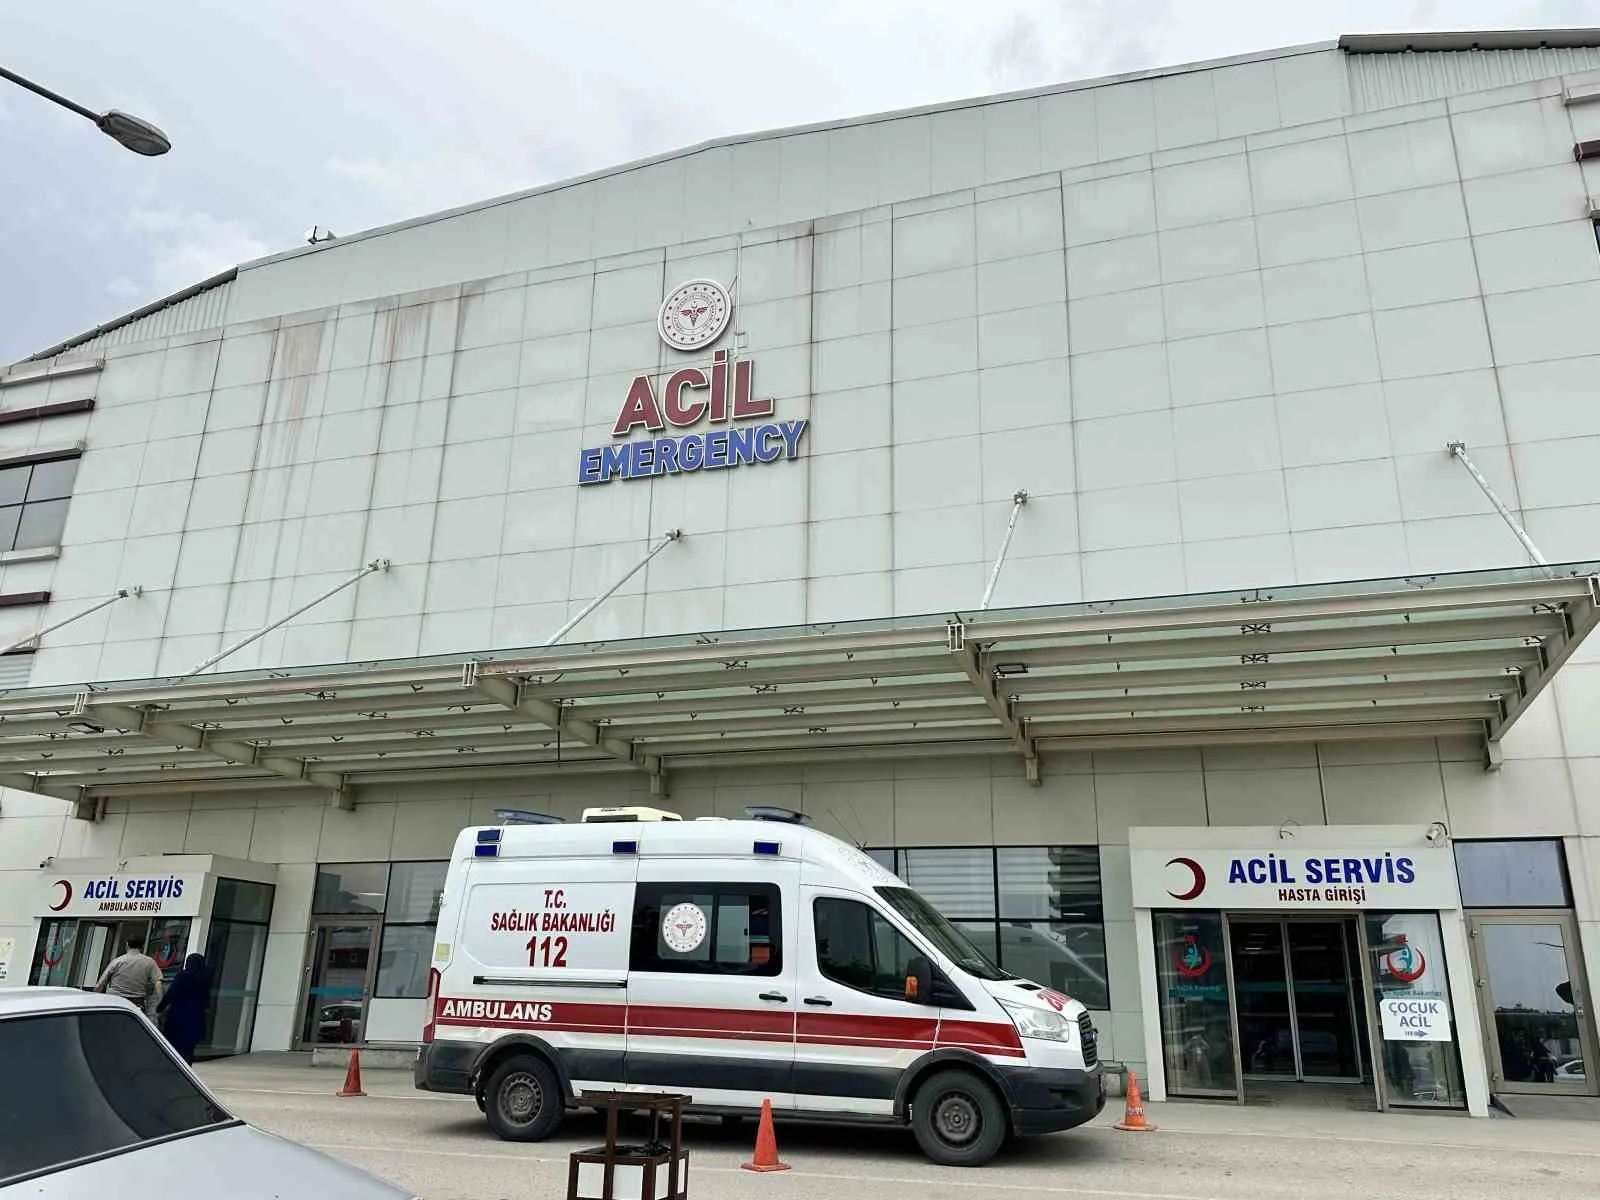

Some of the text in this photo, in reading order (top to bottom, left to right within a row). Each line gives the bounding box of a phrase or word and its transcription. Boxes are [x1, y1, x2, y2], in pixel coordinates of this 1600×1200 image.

[611, 348, 774, 436] ACİL
[578, 418, 808, 485] EMERGENCY
[1228, 852, 1415, 884] ACİL SERVİS
[84, 875, 183, 898] ACİL SERVİS
[1278, 886, 1366, 904] HASTA GİRİŞİ
[98, 901, 138, 911] AMBULANS
[544, 889, 567, 909] T.C.
[491, 909, 615, 932] SAĞLIK BAKANLIĞI
[526, 936, 568, 967] 112
[442, 1000, 552, 1021] AMBULANS
[1388, 1001, 1439, 1016] ÇOCUK
[1400, 1014, 1432, 1027] ACİL
